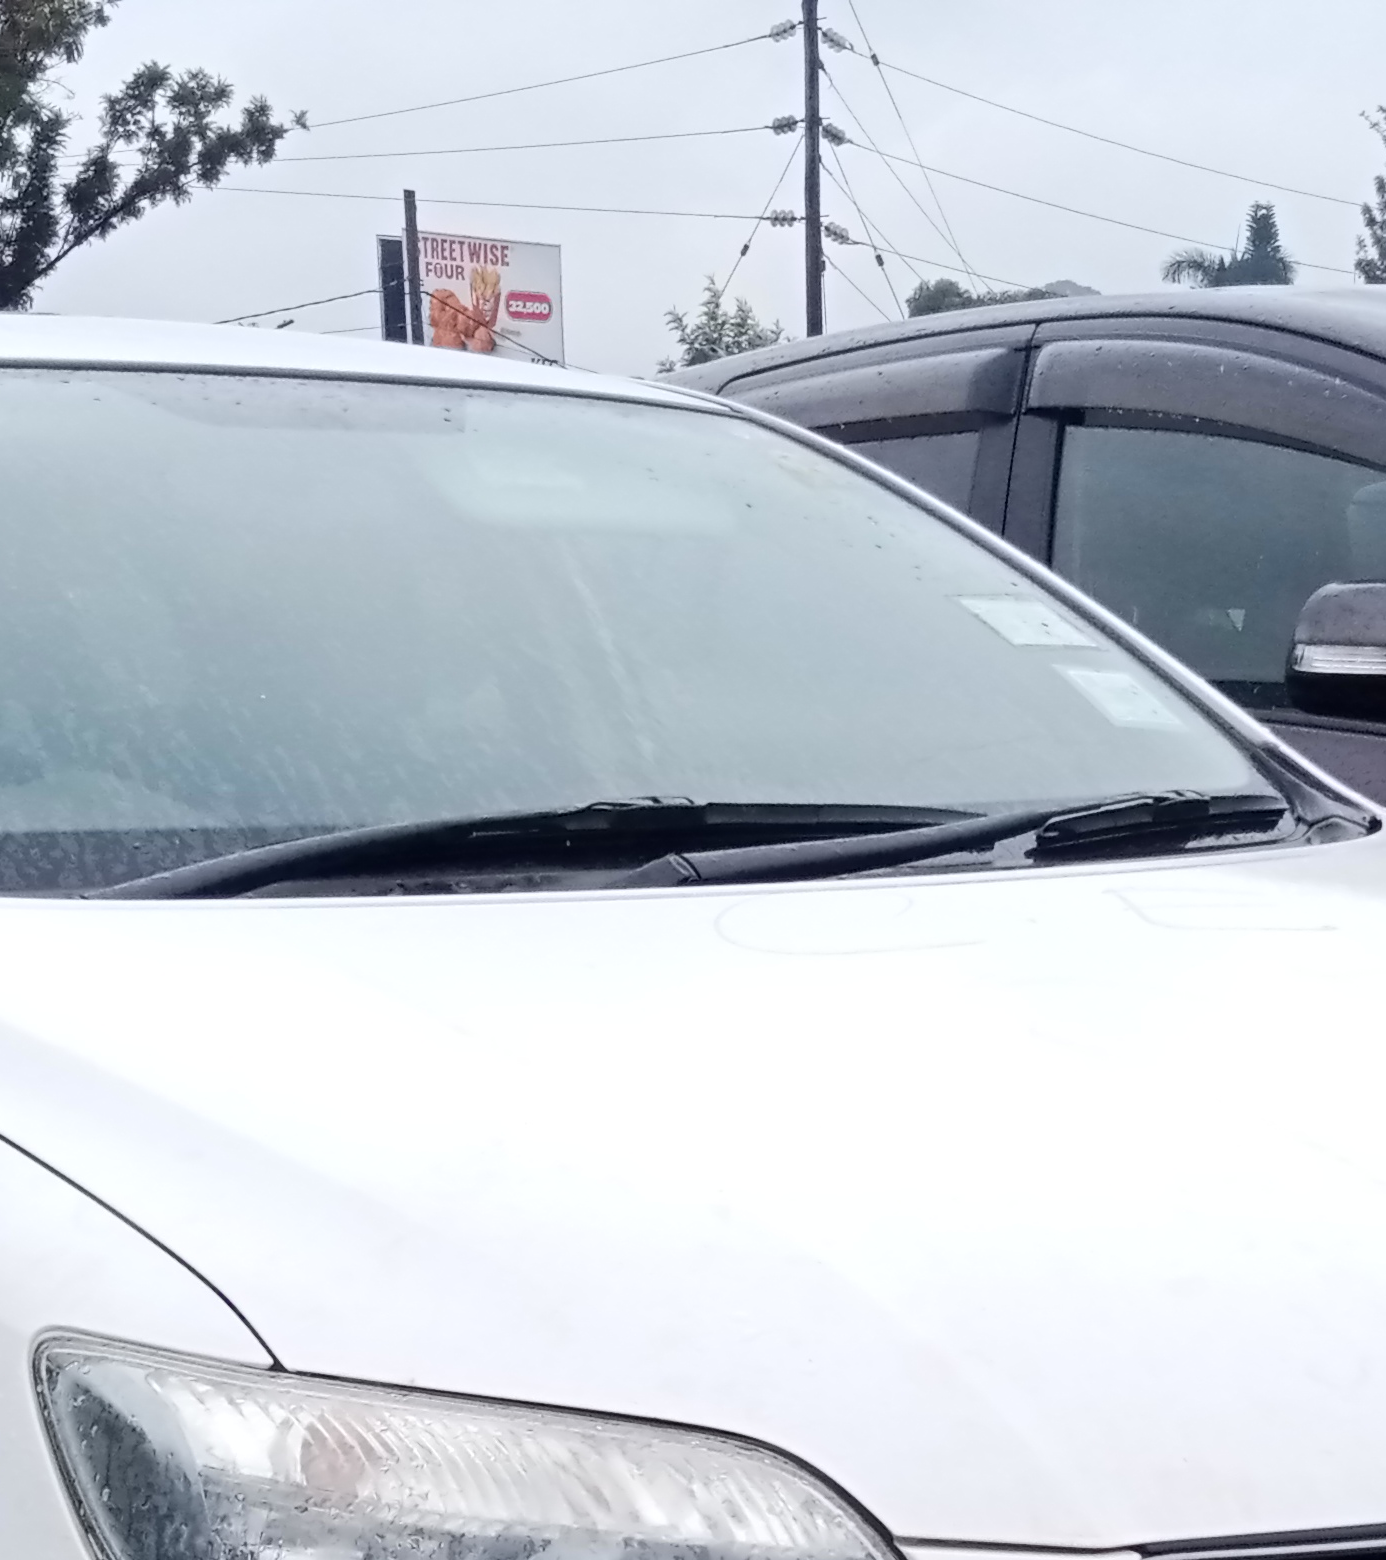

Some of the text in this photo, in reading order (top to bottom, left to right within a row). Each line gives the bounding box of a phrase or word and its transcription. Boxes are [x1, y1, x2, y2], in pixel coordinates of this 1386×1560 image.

[417, 236, 509, 267] TREETWISE
[425, 262, 465, 281] FOUR
[508, 300, 550, 315] 32,500
